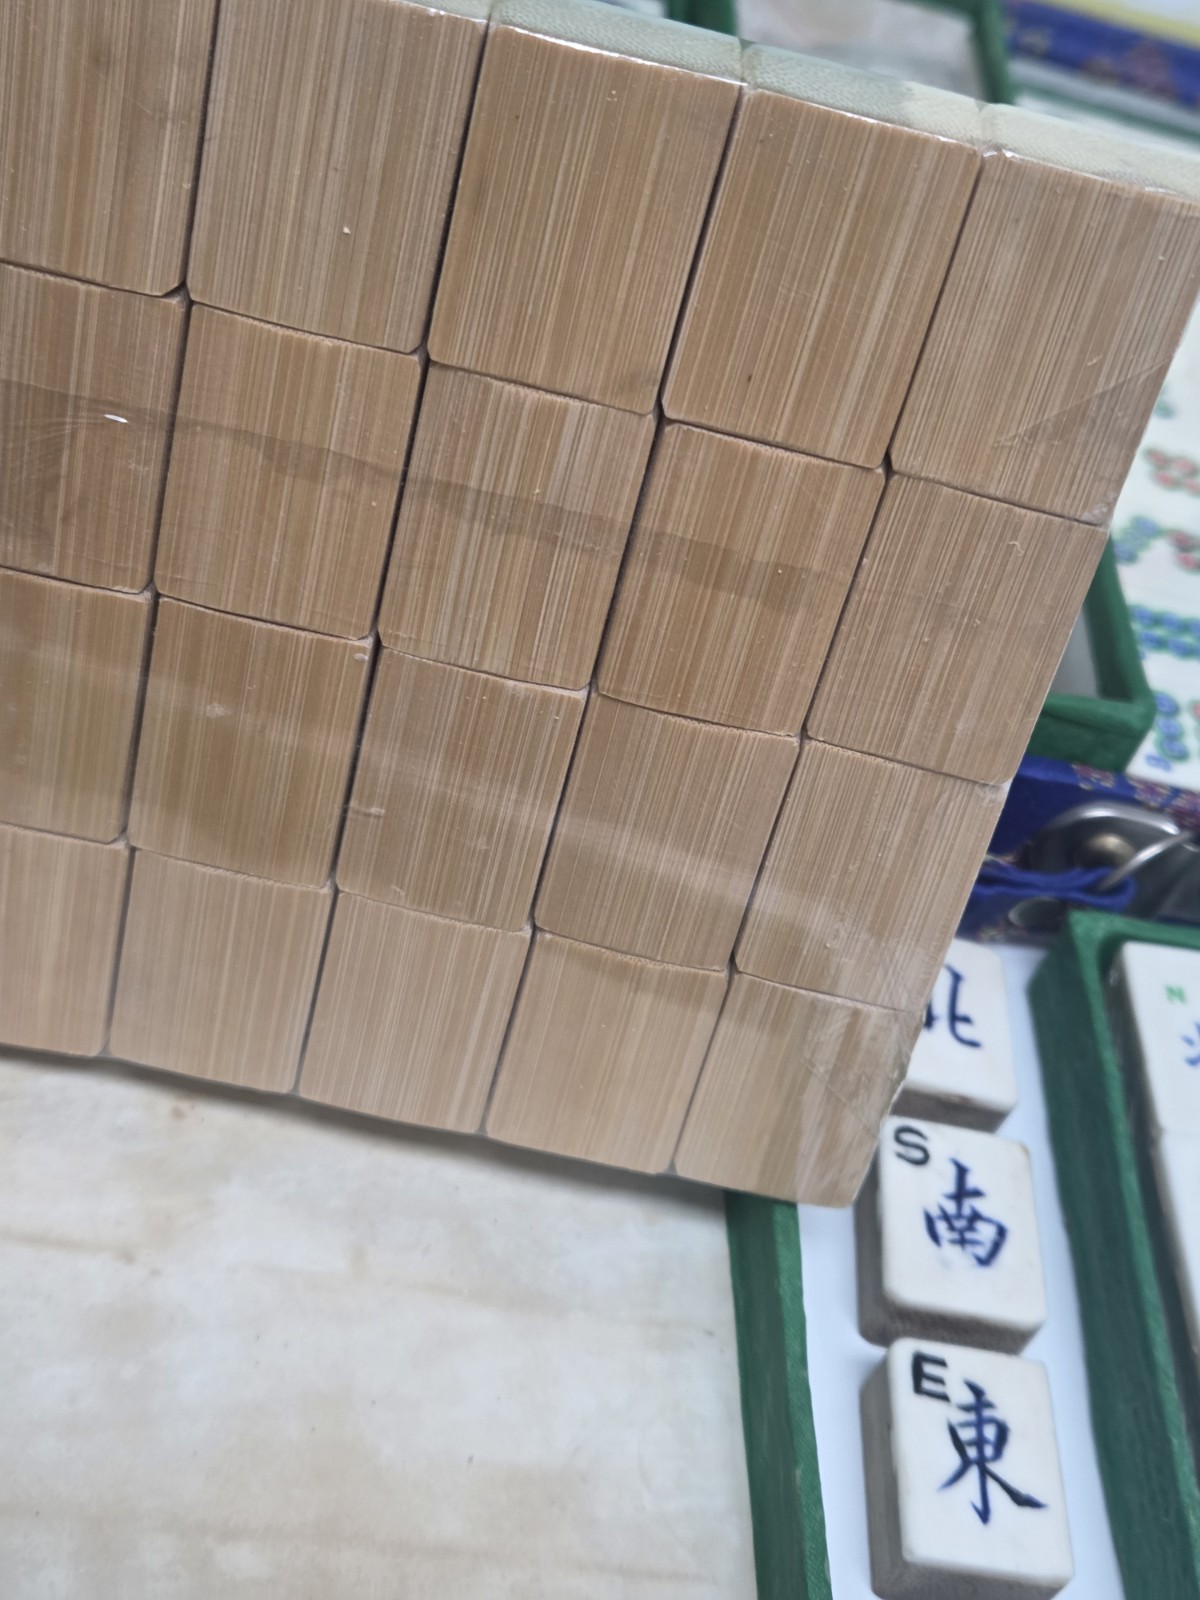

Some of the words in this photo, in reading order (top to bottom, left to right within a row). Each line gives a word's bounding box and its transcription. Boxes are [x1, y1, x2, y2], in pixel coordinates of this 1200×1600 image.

[893, 1124, 930, 1167] S
[923, 1157, 1008, 1267] 南
[911, 1351, 951, 1403] E
[936, 1378, 1048, 1526] 東
